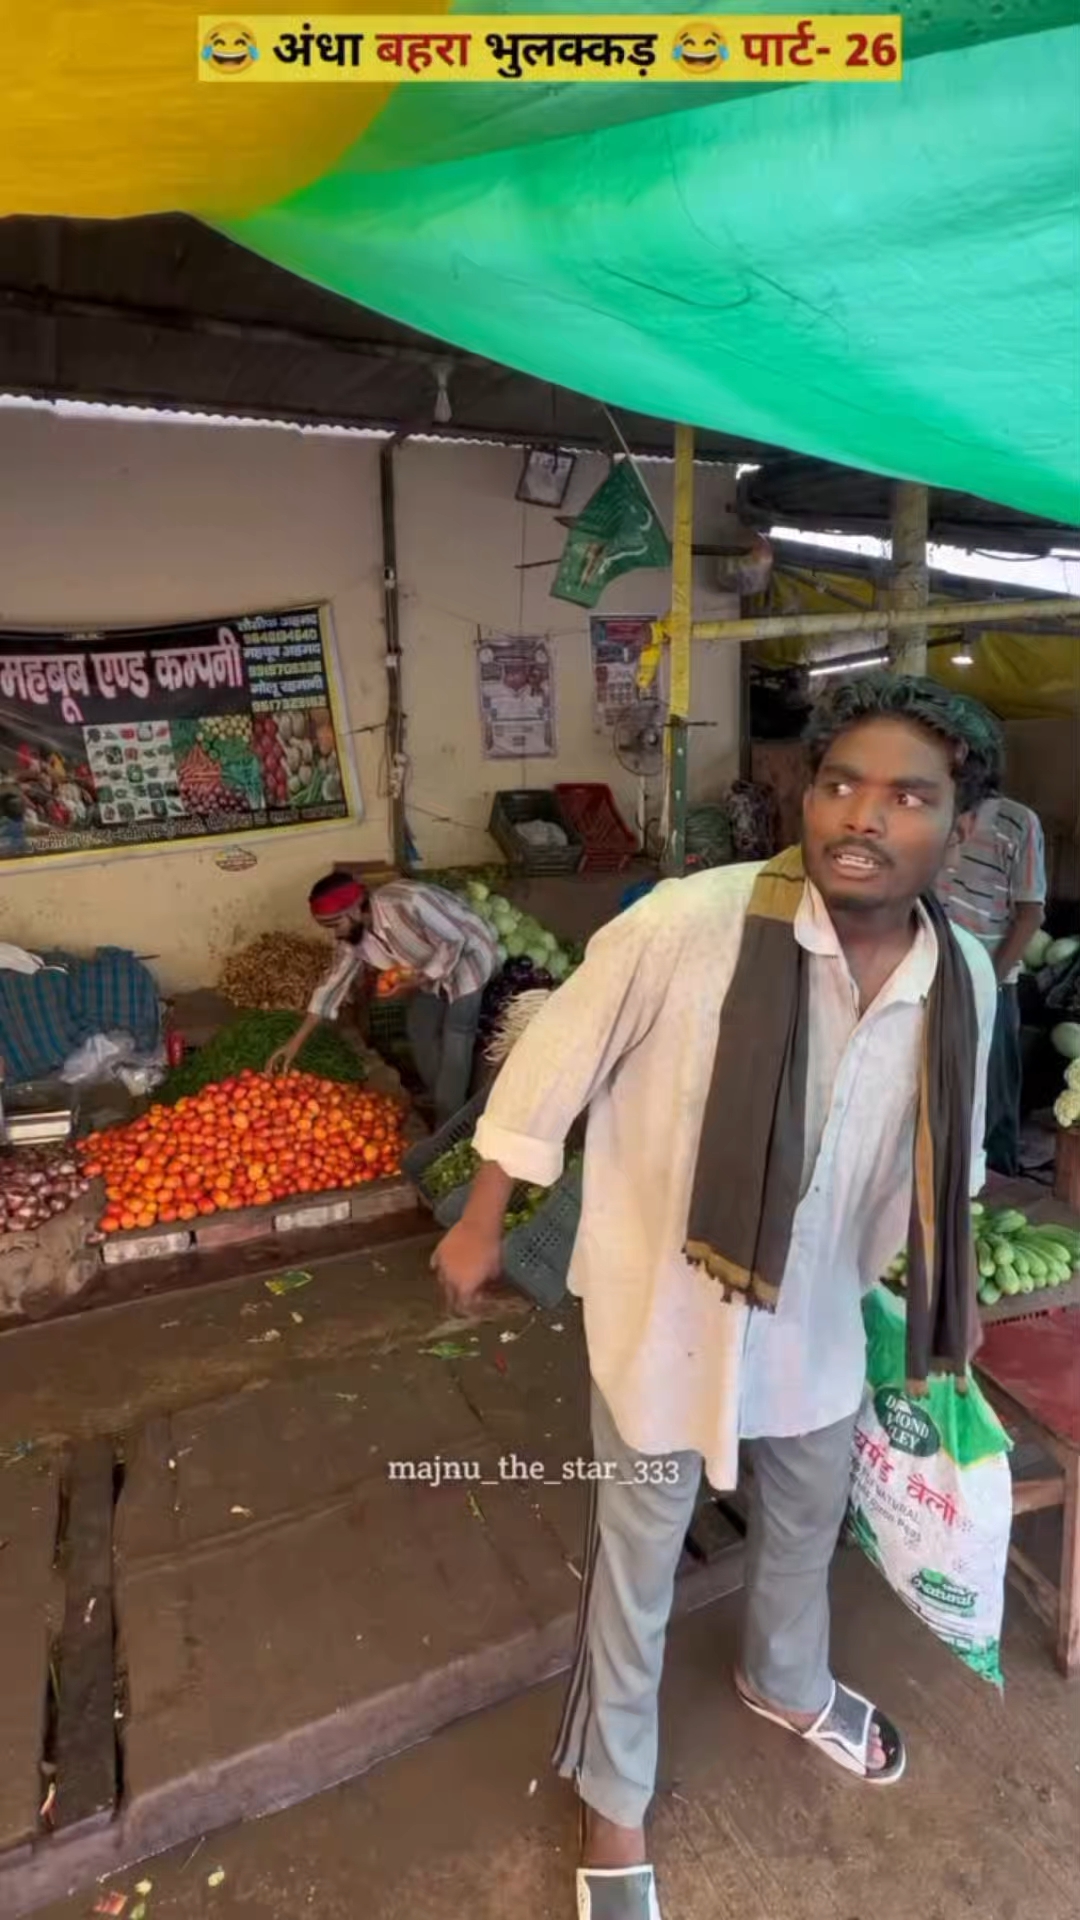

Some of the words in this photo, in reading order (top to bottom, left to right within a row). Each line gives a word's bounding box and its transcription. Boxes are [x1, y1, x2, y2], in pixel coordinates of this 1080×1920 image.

[0, 654, 88, 723] महबूब
[93, 653, 150, 698] एण्ड
[151, 626, 243, 691] कम्पनी
